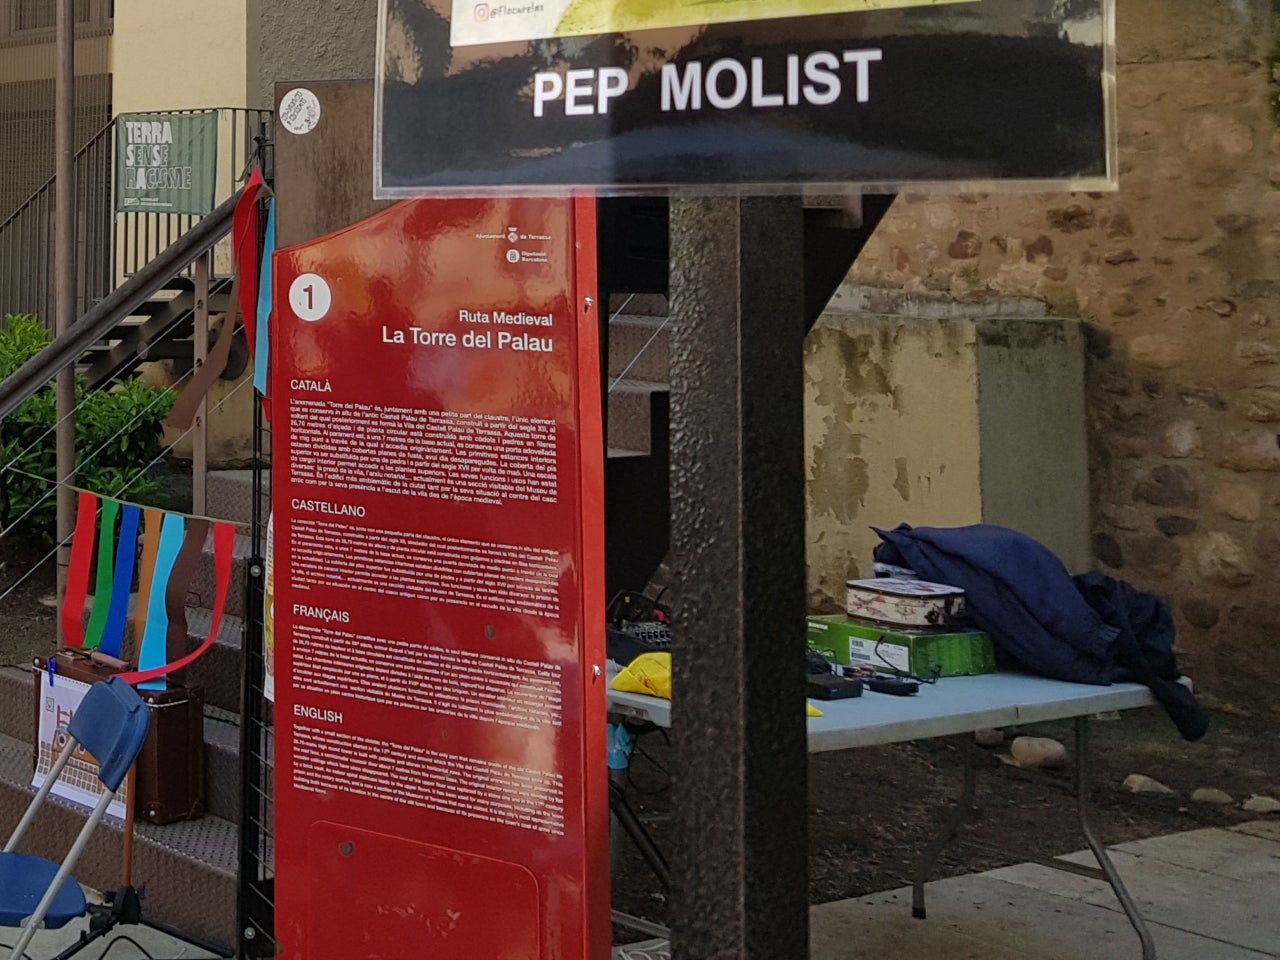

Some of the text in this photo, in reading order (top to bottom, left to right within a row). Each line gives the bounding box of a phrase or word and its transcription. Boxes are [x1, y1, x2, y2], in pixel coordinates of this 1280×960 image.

[532, 47, 883, 118] PEP MOLIST
[126, 122, 172, 144] TERRA
[126, 144, 168, 166] SENSE
[126, 166, 192, 190] RACISME
[302, 284, 313, 310] 1
[459, 310, 553, 326] Ruta Medieval
[382, 326, 553, 352] La Torre del Palau
[290, 378, 332, 392] CATALÀ
[332, 416, 370, 425] posteriorment
[291, 498, 366, 518] CASTELLANO
[292, 604, 350, 624] FRANÇAIS
[293, 704, 343, 724] ENGLISH
